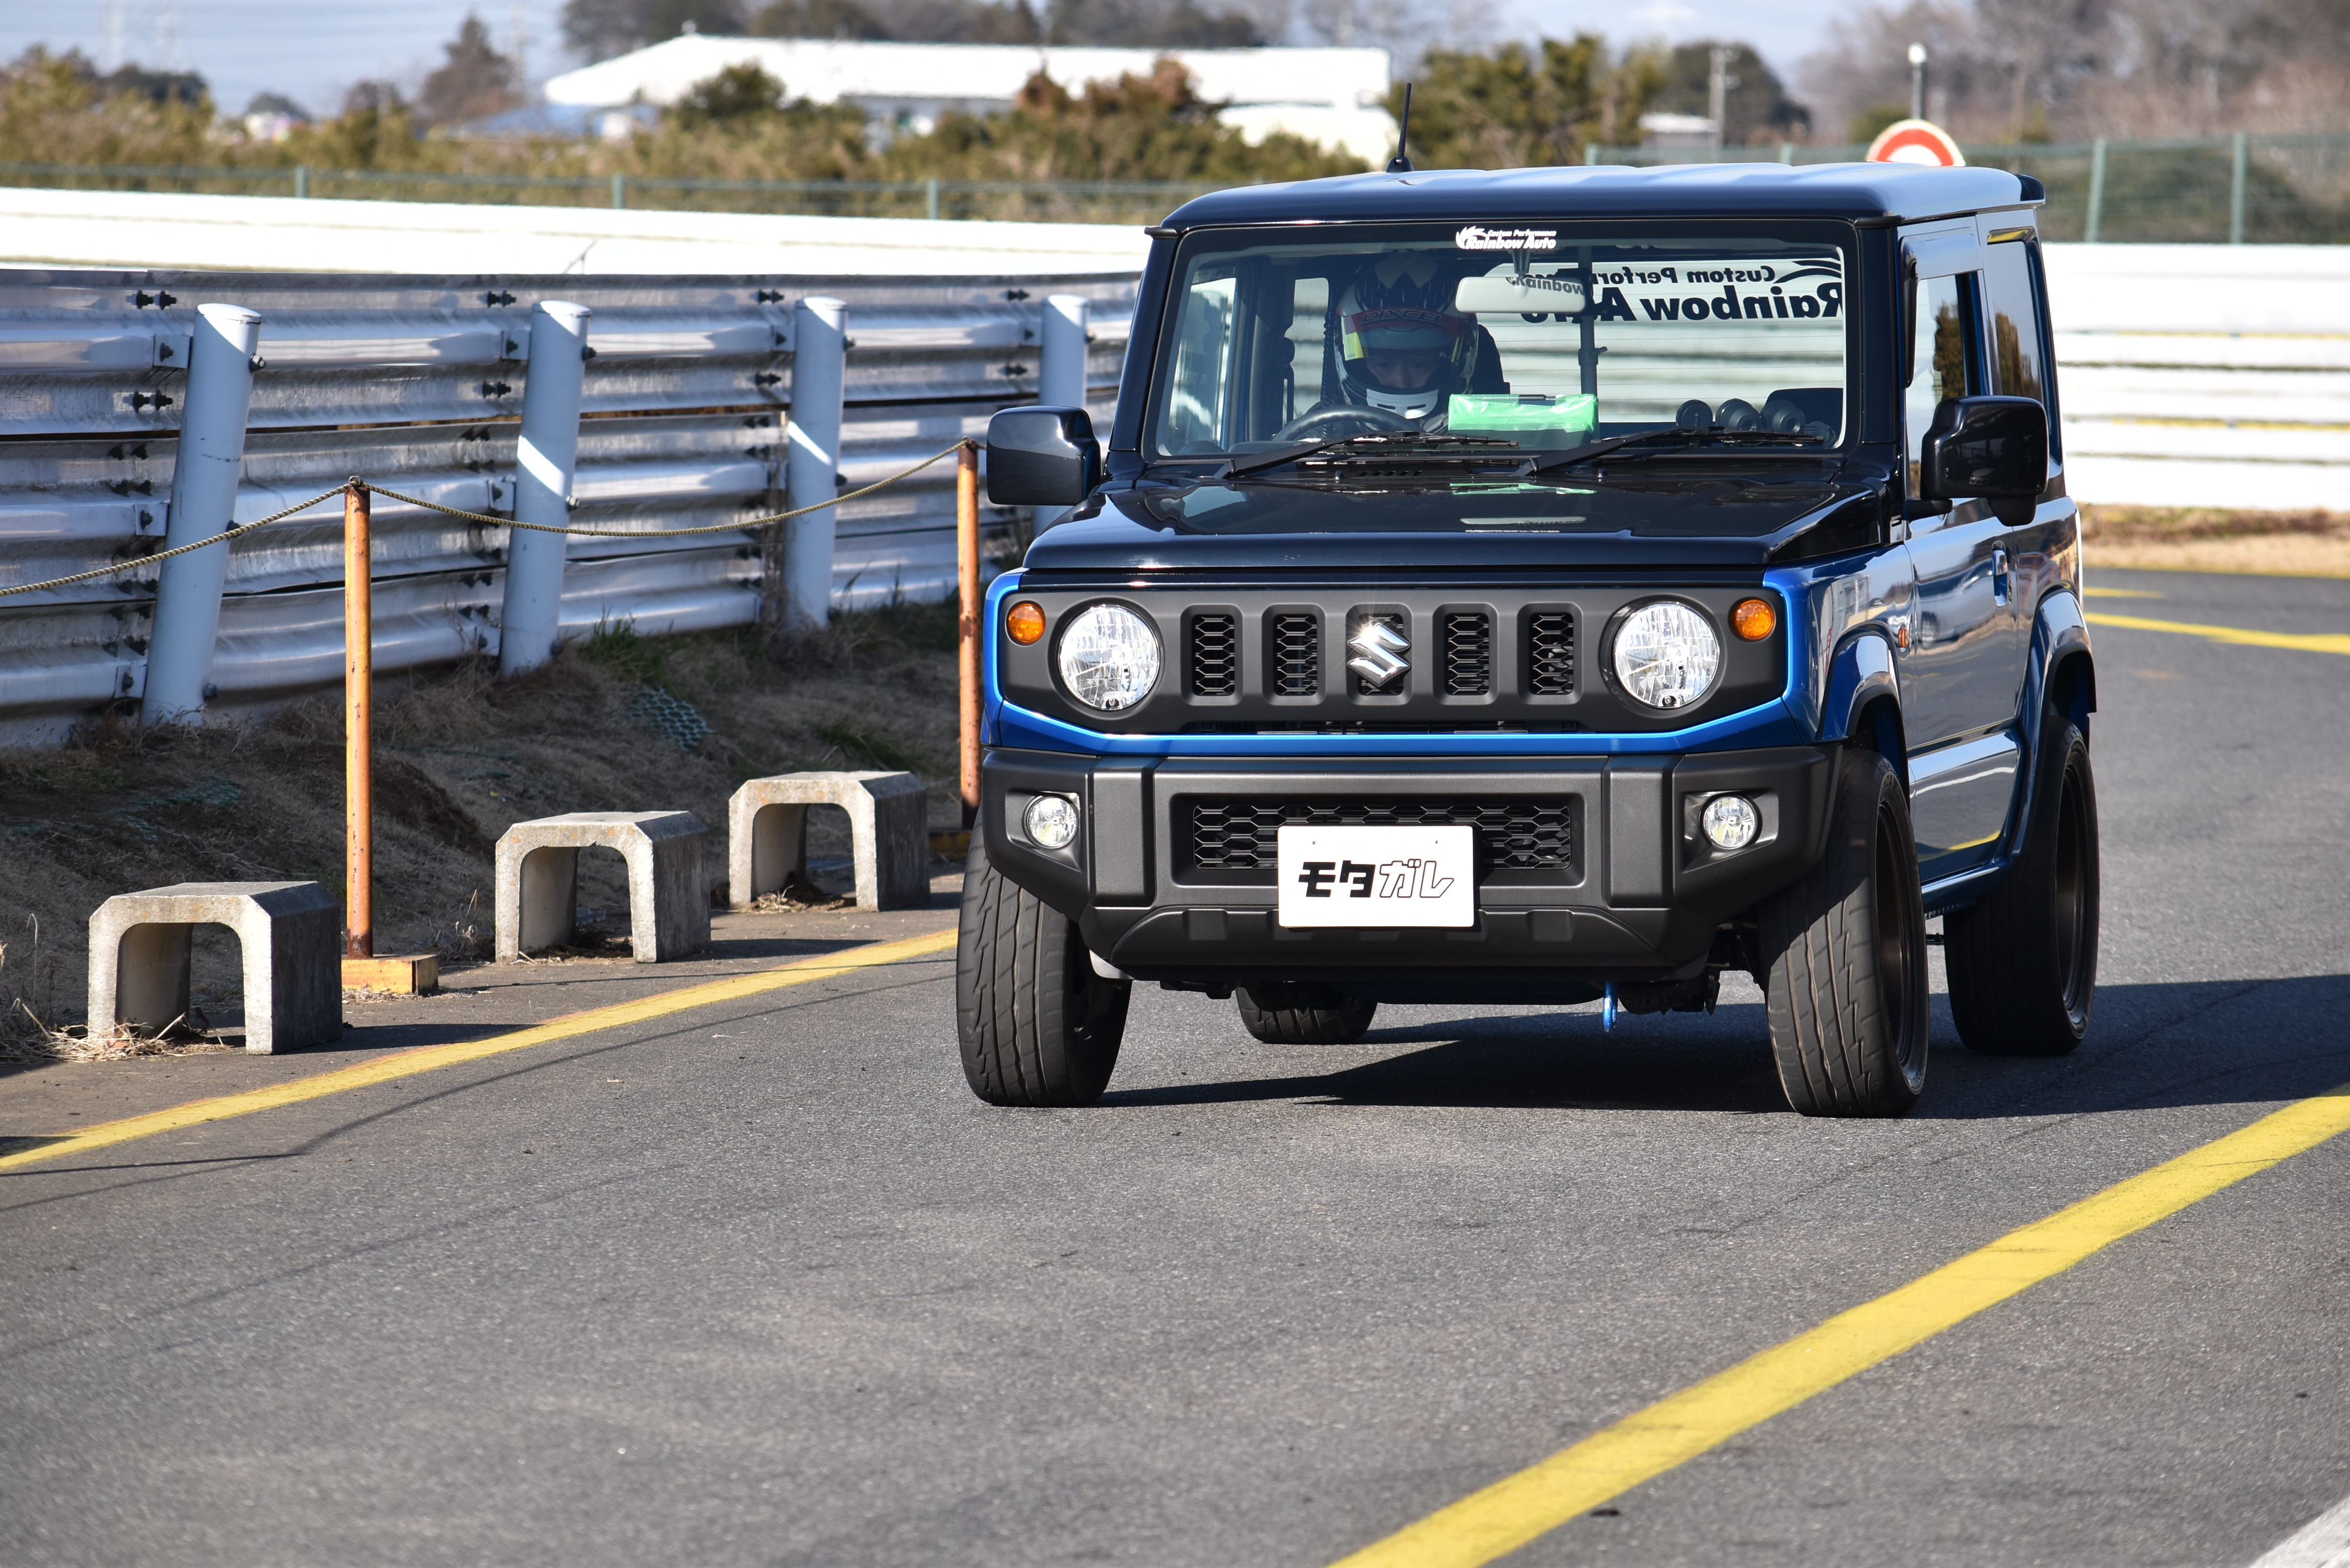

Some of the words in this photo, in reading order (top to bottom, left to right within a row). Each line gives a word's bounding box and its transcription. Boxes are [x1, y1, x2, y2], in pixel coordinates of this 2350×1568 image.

[1466, 236, 1524, 249] Rainbow
[1524, 236, 1556, 248] Auto
[1362, 309, 1447, 327] DIXCEL
[1298, 859, 1454, 898] モタガレ
